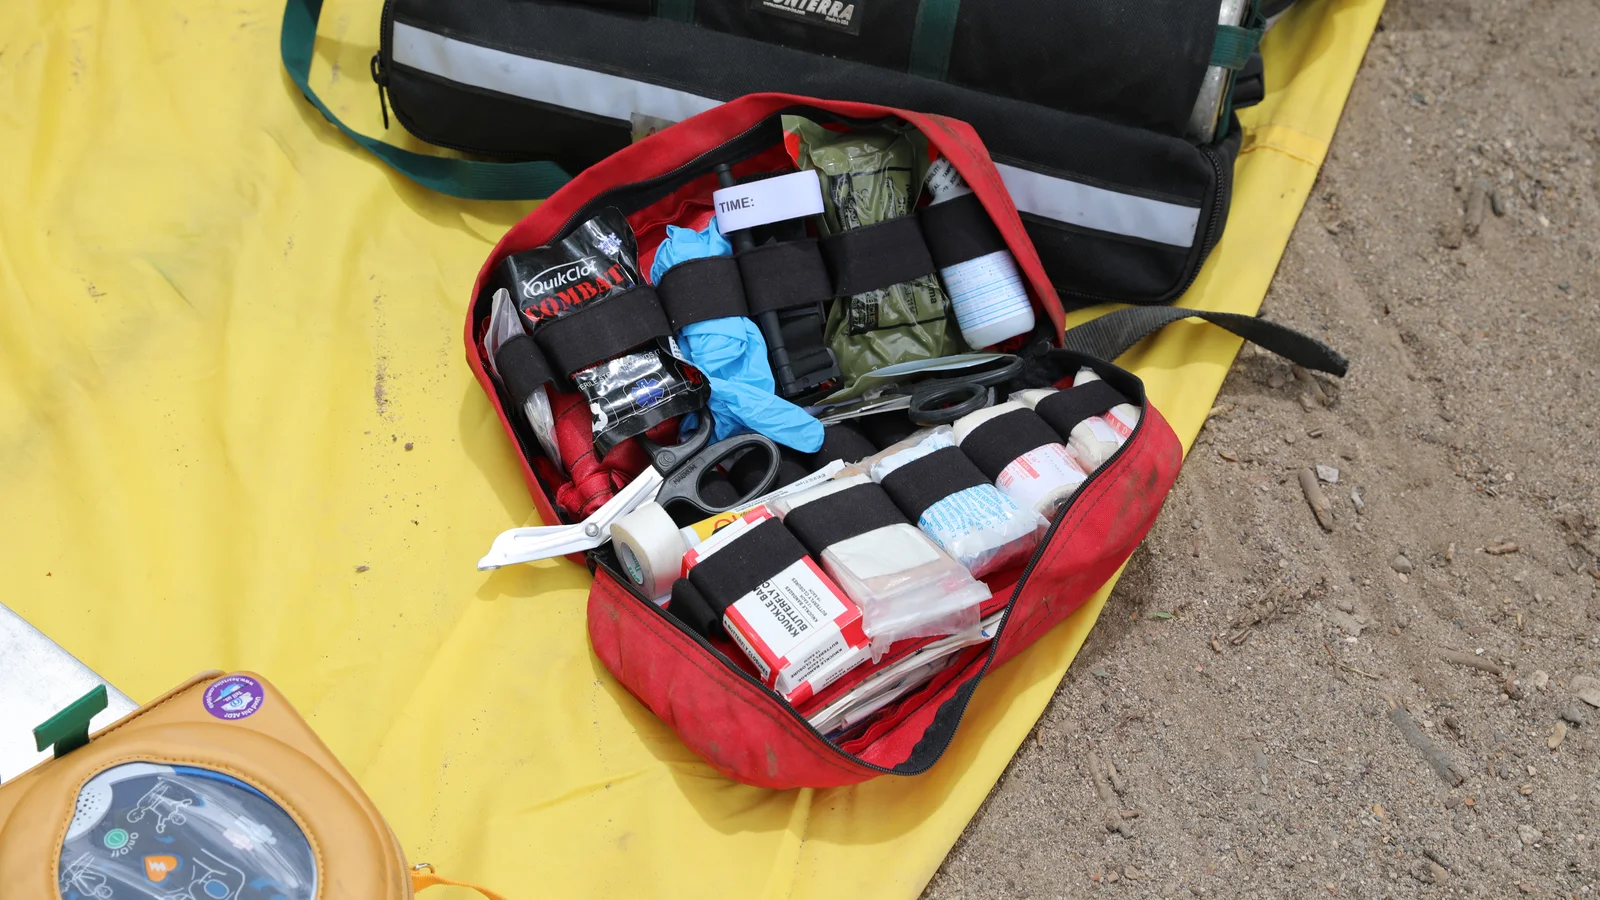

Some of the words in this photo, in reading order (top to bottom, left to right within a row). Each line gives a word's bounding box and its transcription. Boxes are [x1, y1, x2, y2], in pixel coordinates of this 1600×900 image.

[764, 0, 855, 20] TERRA
[719, 196, 755, 213] TIME:
[527, 259, 598, 297] QuikClot
[524, 263, 624, 322] COMBAT
[784, 586, 803, 606] BANDAGES
[791, 577, 810, 597] CLOSURES
[767, 588, 809, 632] BUTTERFLY
[801, 603, 818, 622] KNUCKLE
[809, 595, 828, 617] BUTTERFLY
[764, 600, 800, 638] KNUCKLE
[727, 625, 748, 651] BUTTERFLY
[747, 650, 768, 676] CLOSURES
[812, 641, 839, 662] BUTTERFLY
[821, 648, 843, 665] KNUCKLE
[790, 660, 812, 679] CLOSURE
[798, 664, 820, 682] BANDAGE
[250, 696, 262, 710] Used
